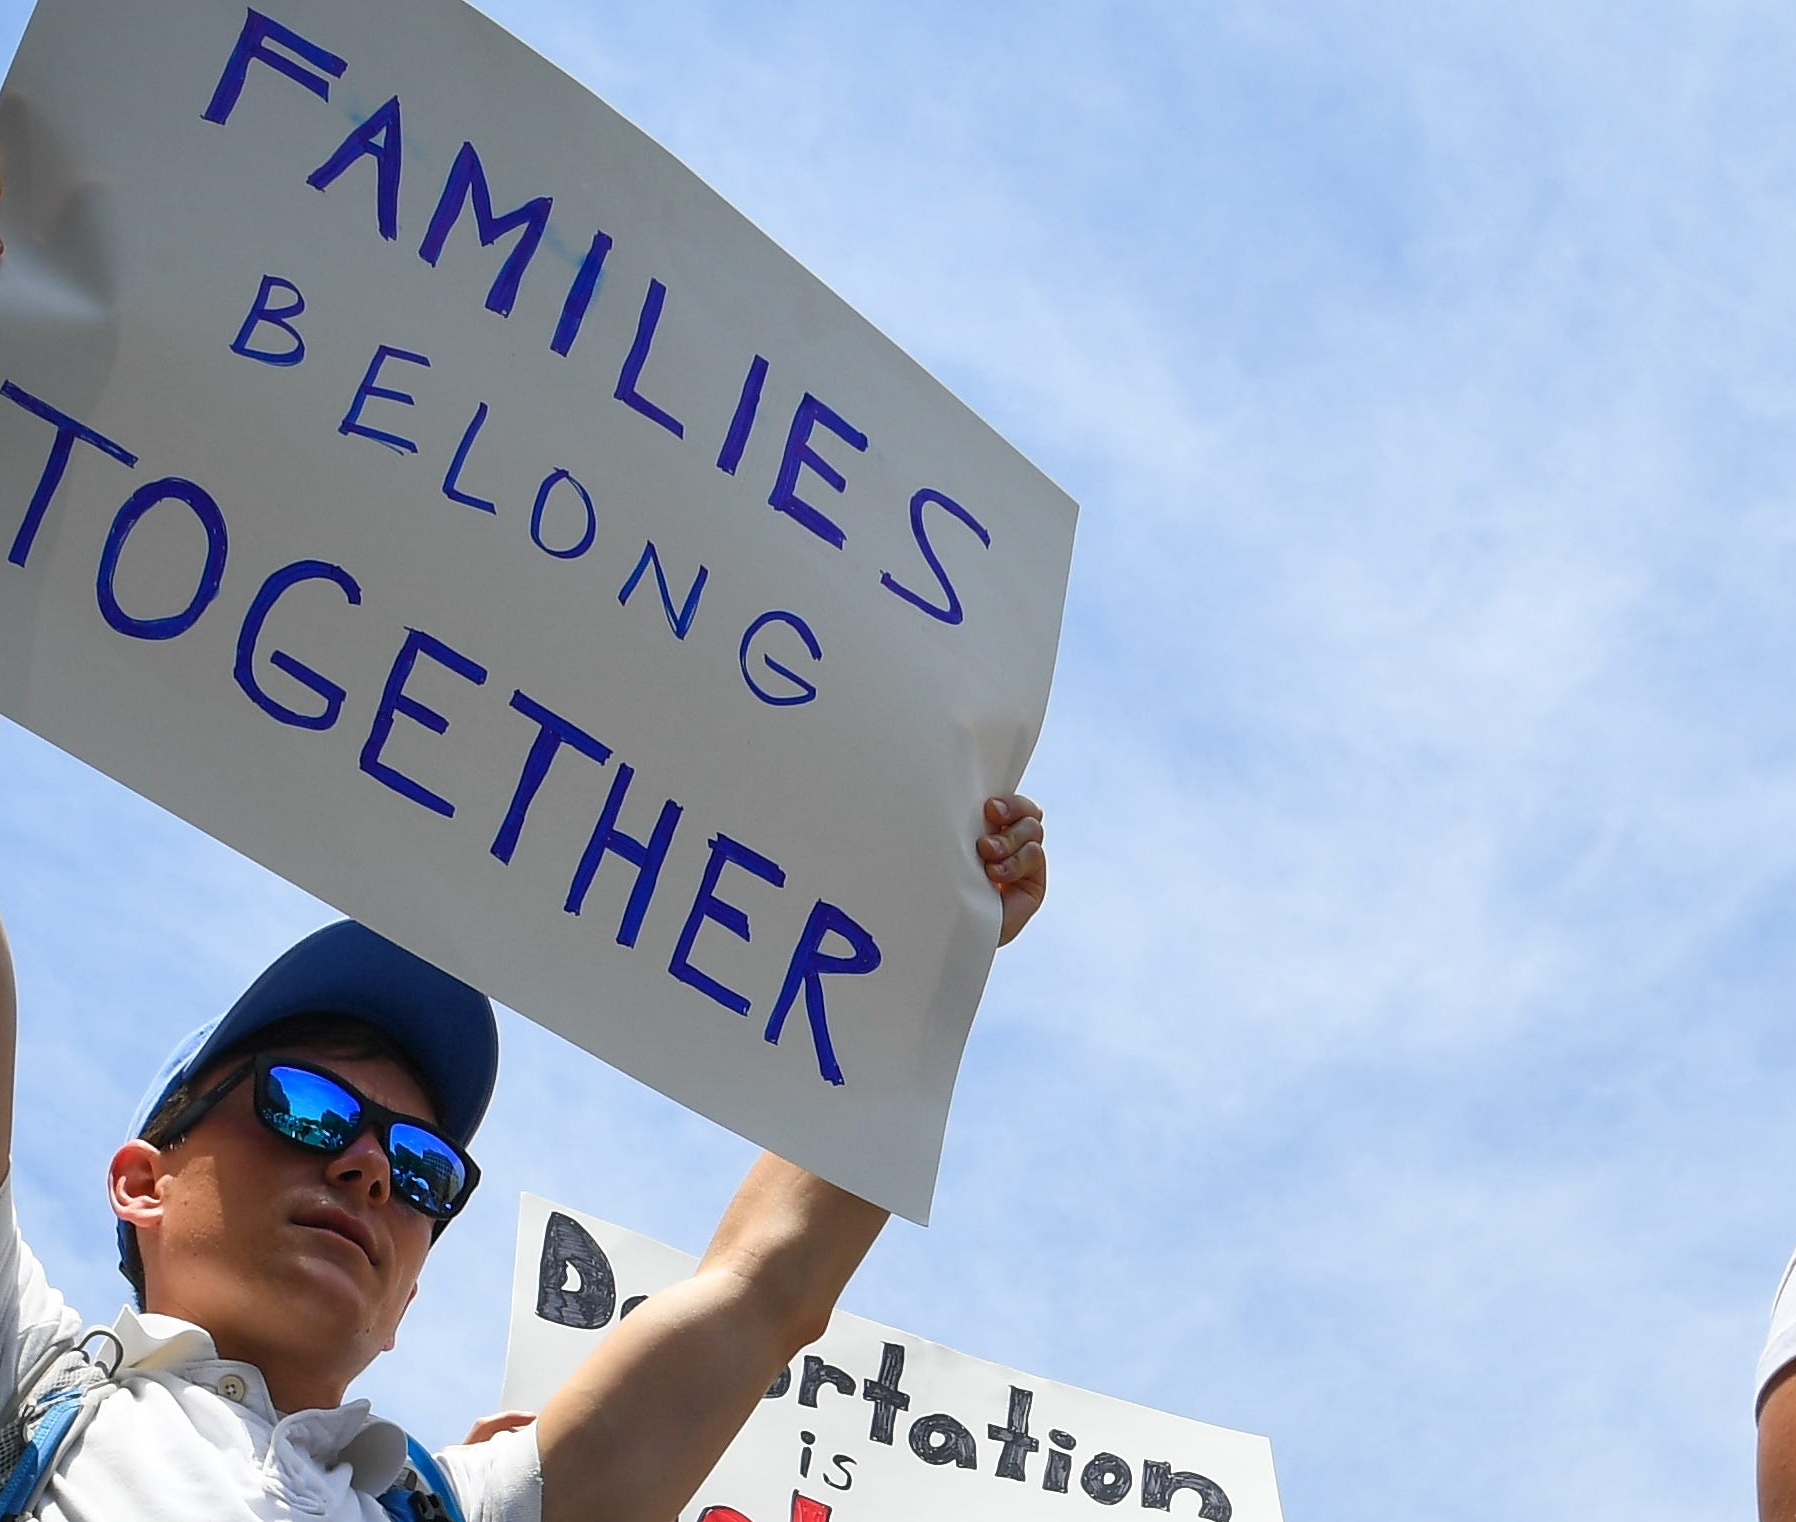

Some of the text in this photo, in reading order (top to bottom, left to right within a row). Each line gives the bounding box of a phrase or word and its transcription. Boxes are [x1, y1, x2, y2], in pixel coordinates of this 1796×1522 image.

[201, 7, 992, 626] FAMILIES
[229, 274, 824, 706] BELONG
[0, 379, 883, 1087] TOGETHER
[799, 1429, 858, 1491] is
